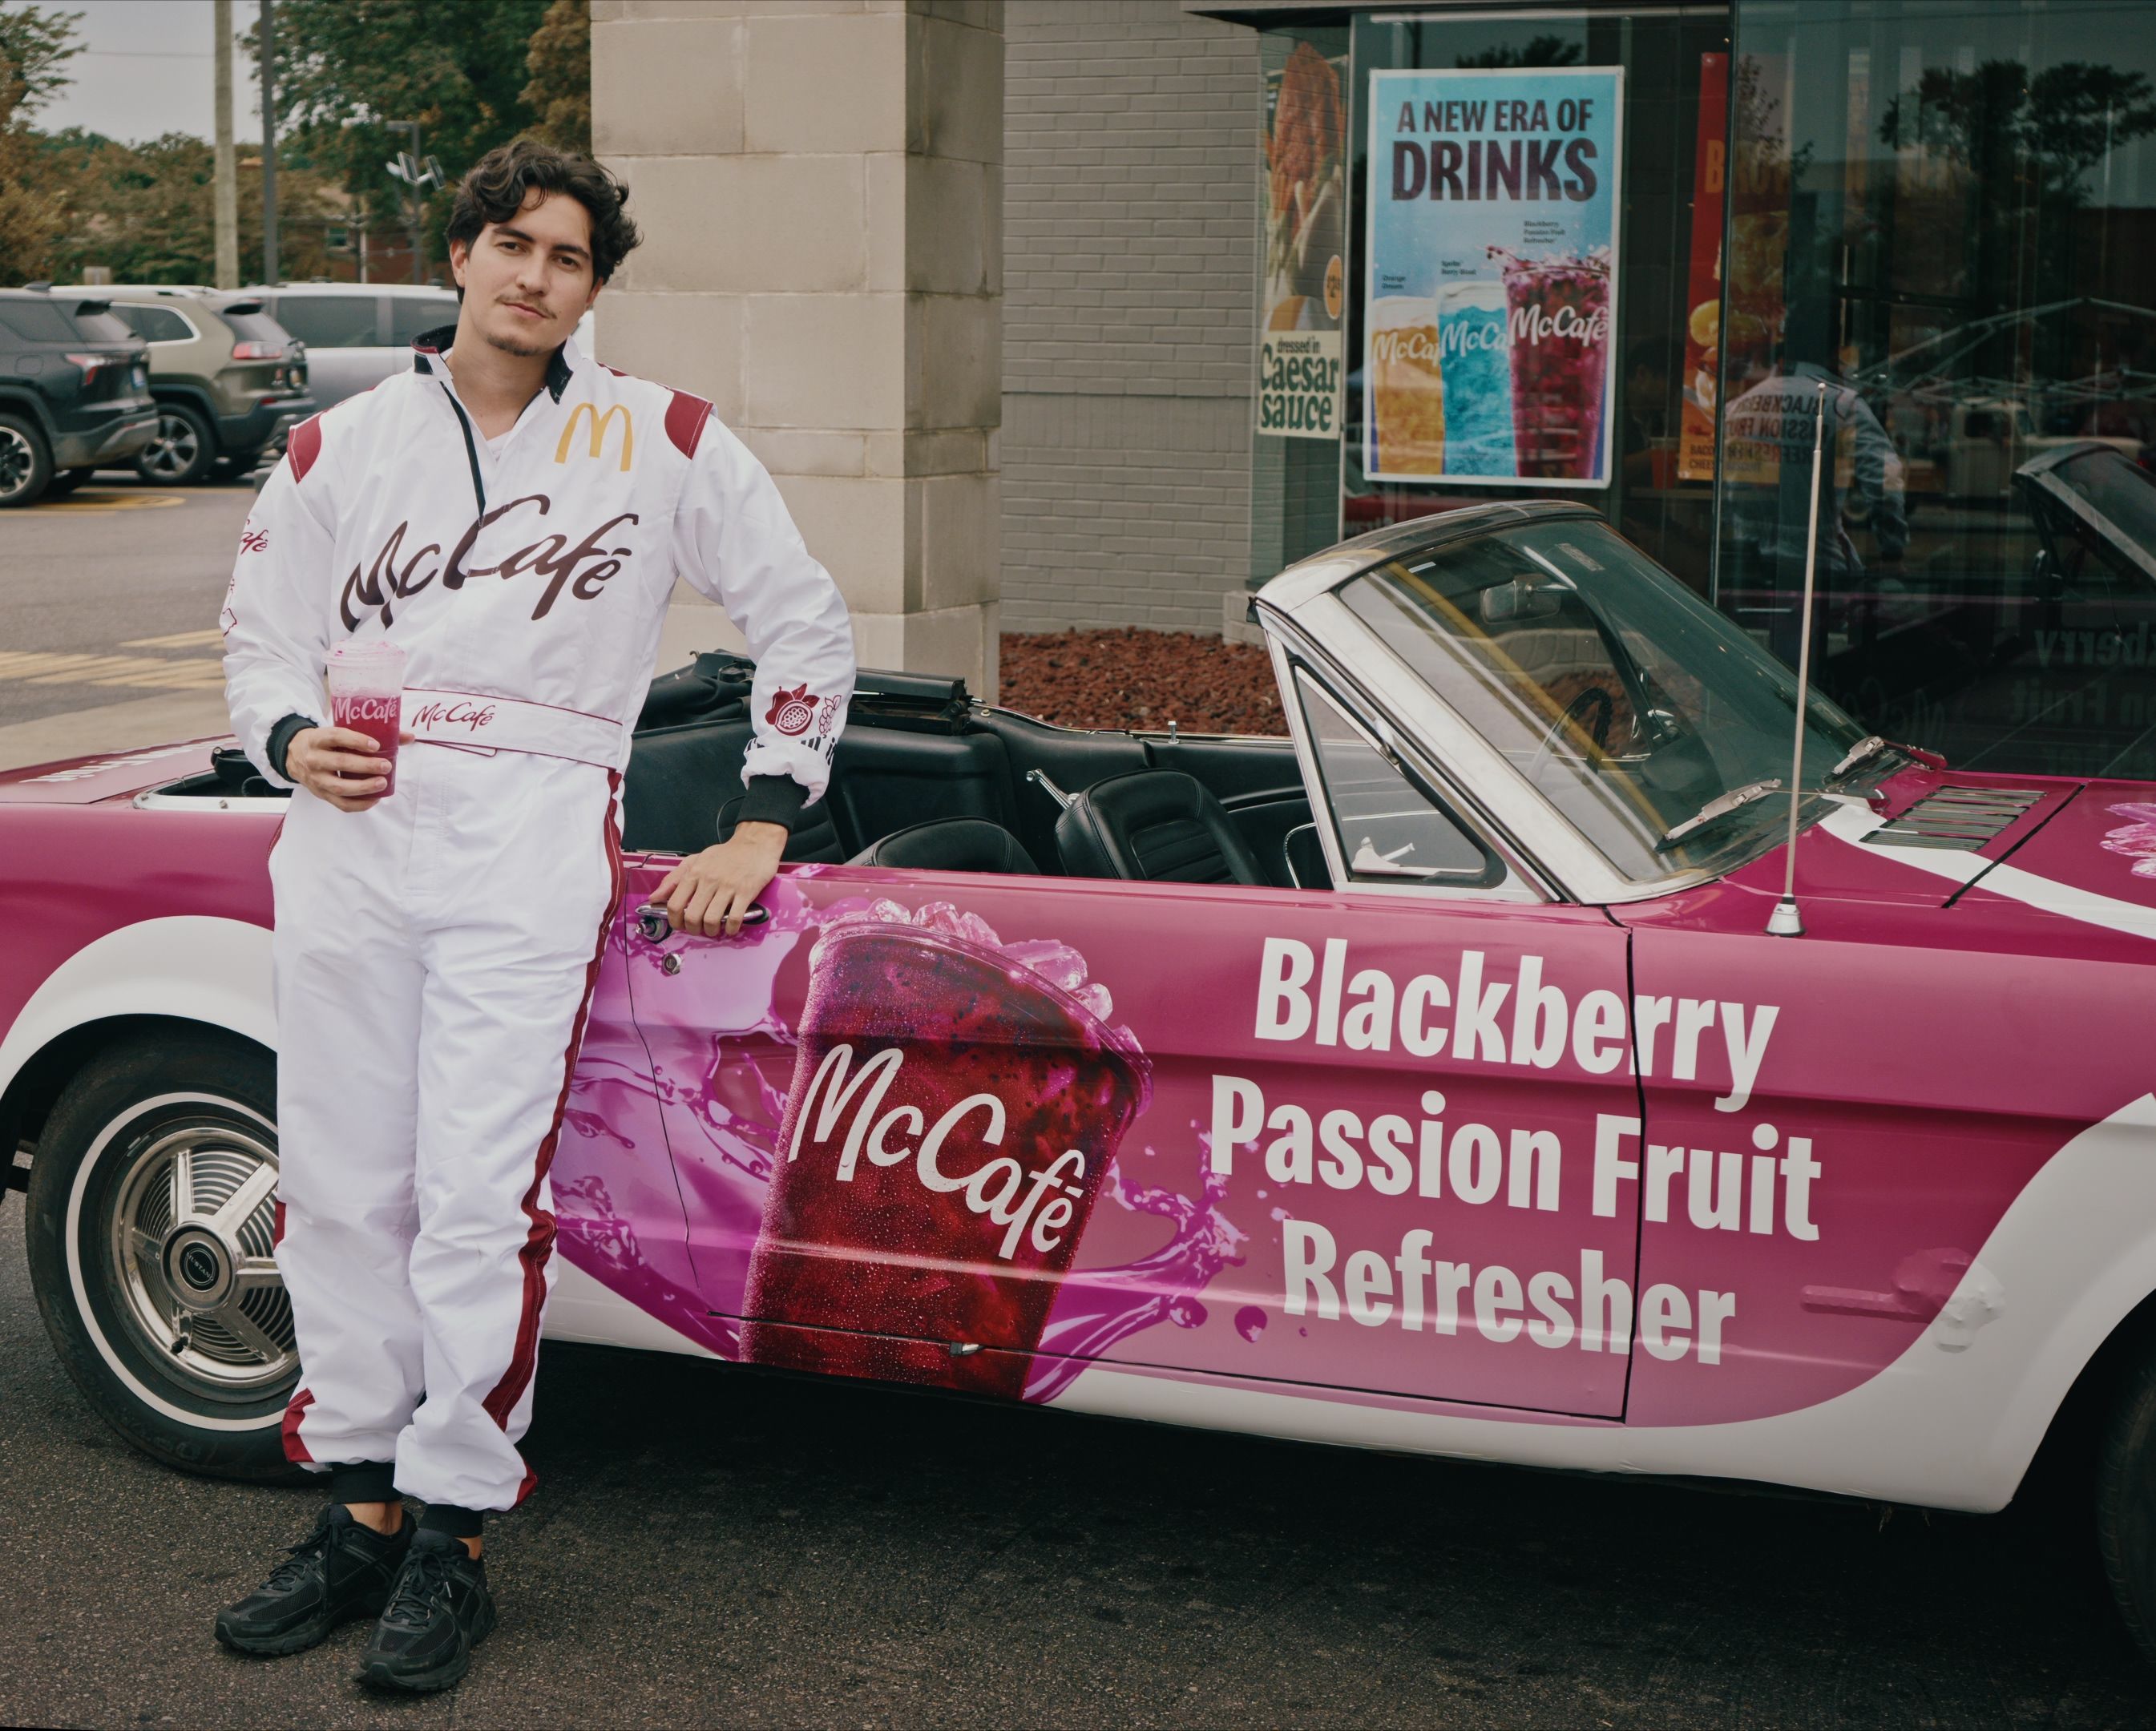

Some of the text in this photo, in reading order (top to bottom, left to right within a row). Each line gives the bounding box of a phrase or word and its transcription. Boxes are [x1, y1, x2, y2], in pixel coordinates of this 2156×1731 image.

[1397, 99, 1594, 132] A NEW ERA OF
[1392, 137, 1598, 201] DRINKS
[1261, 343, 1339, 393] Caesar
[1261, 393, 1332, 432] sauce
[334, 696, 397, 725] McCafé
[411, 701, 495, 732] McCafé
[1254, 936, 1780, 1114] Blackberry
[787, 1043, 1086, 1260] McCafé
[1210, 1074, 1822, 1241] Passion Fruit
[1282, 1218, 1736, 1366] Refresher
